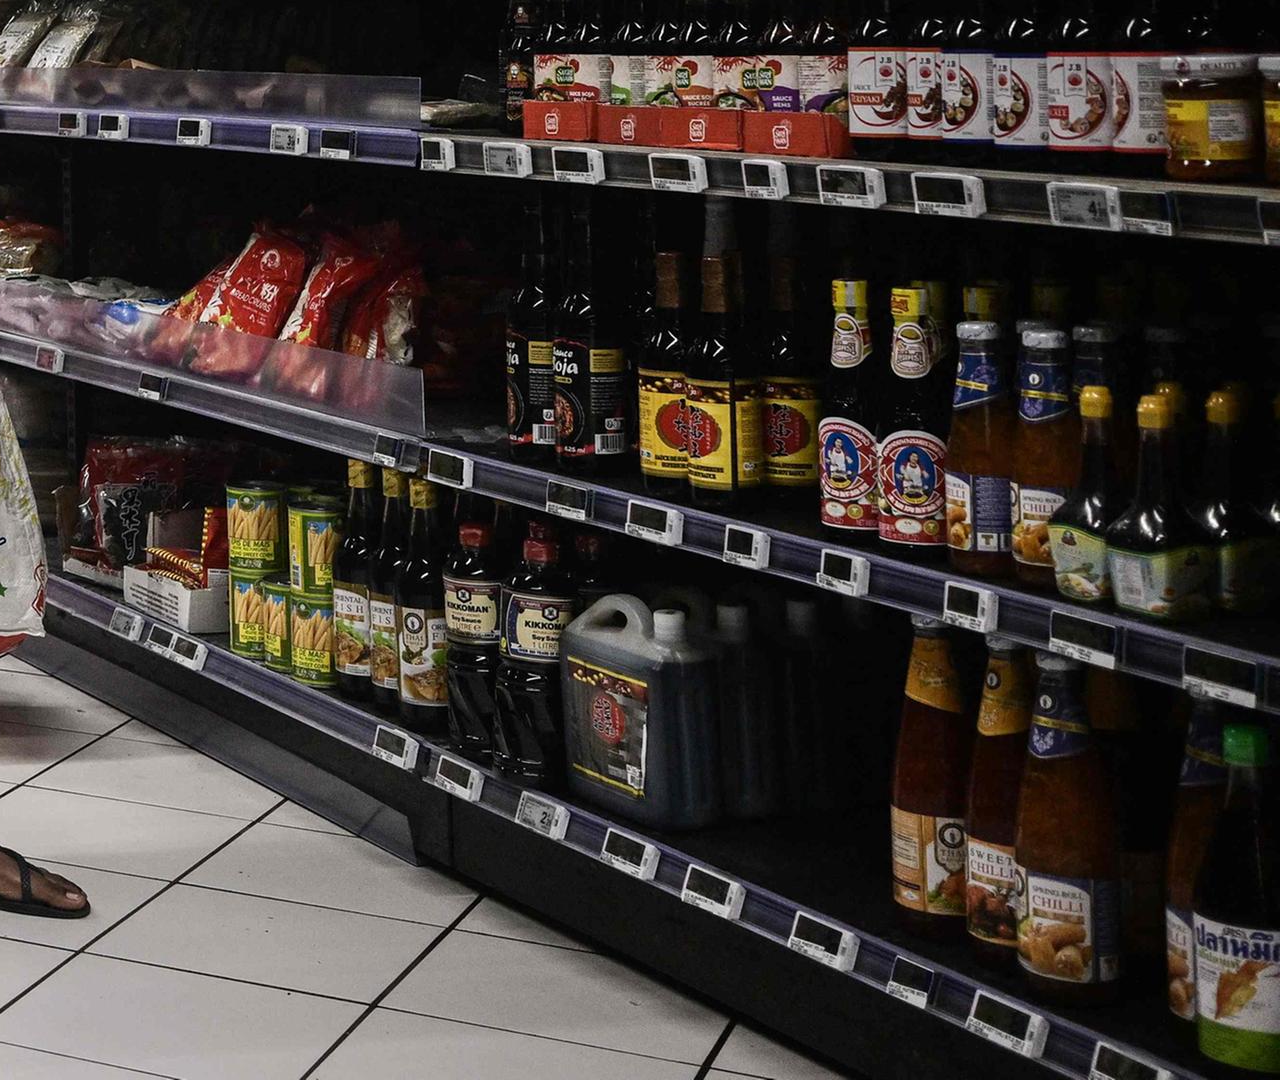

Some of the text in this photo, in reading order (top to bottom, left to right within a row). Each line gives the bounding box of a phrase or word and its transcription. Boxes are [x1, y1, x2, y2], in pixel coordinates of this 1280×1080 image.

[447, 601, 489, 613] KIKKOMAN
[372, 614, 391, 625] FIS
[461, 616, 481, 624] Sauce
[970, 849, 1013, 866] SWEET
[971, 861, 1014, 879] CHILLI
[1033, 886, 1057, 897] SPRING
[1033, 895, 1084, 913] CHILLI
